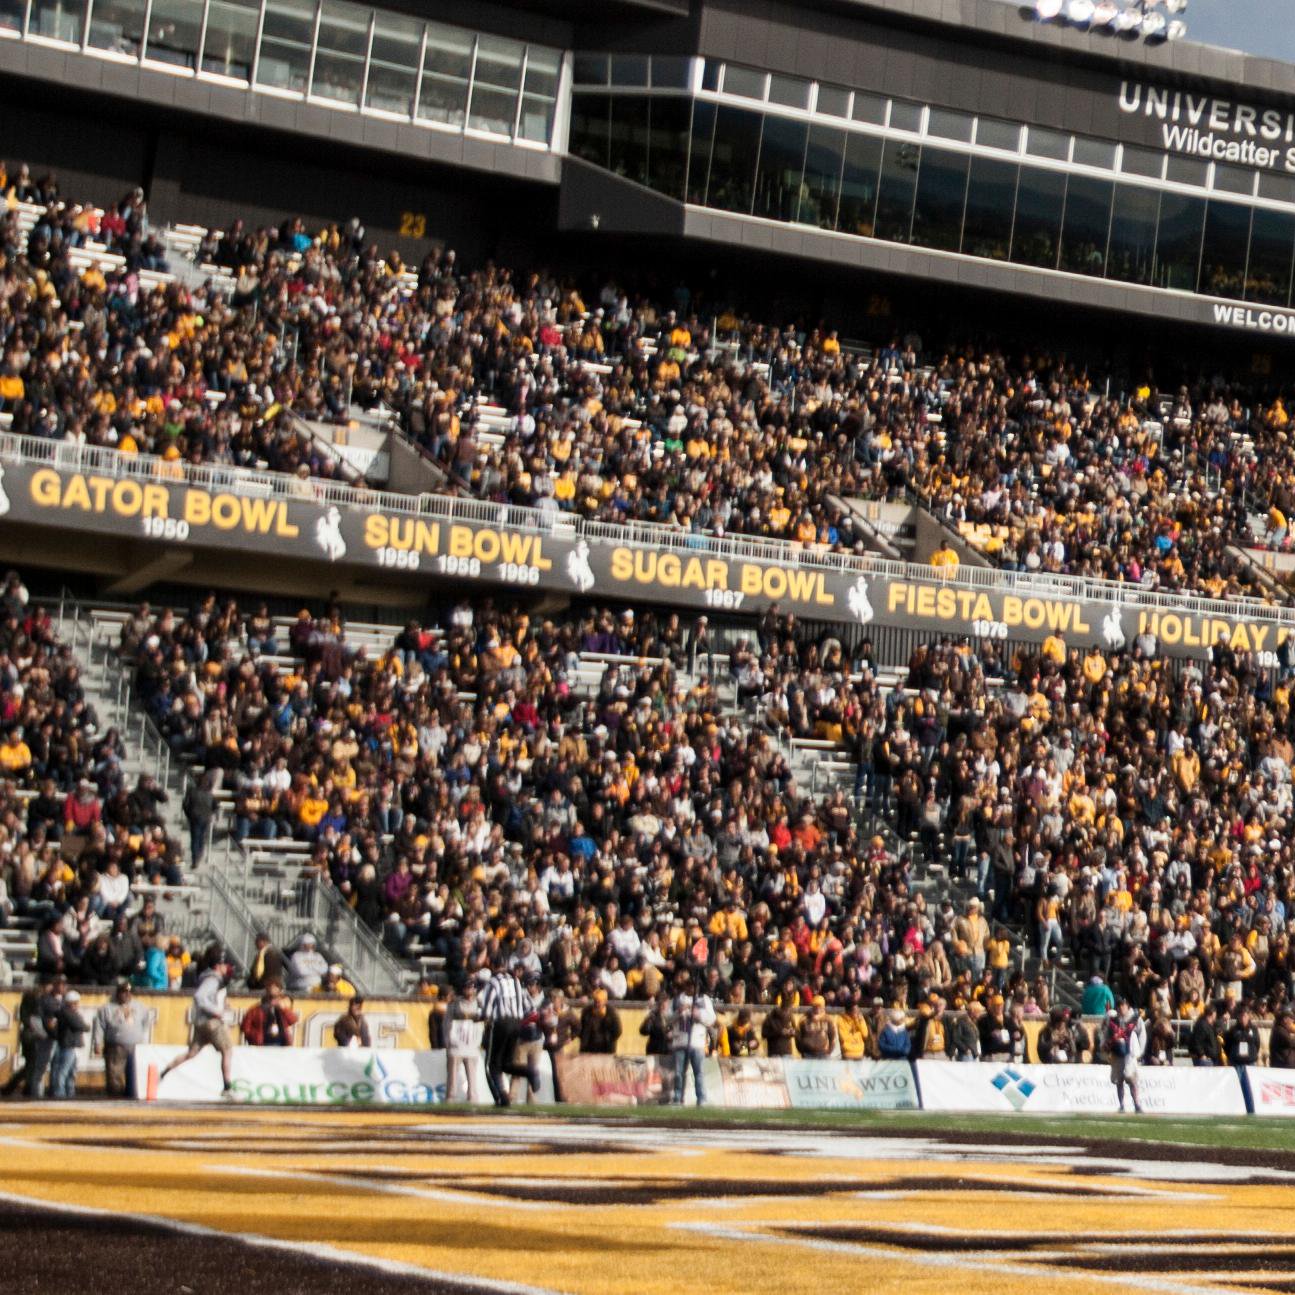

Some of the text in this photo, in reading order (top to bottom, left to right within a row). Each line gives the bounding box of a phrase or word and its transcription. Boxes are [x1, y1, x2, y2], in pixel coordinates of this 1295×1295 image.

[1162, 123, 1280, 168] Wildcatter
[401, 212, 426, 239] 23
[29, 468, 300, 538] GATOR BOWL
[143, 515, 190, 541] 1950
[365, 514, 553, 571] SUN BOWL
[376, 546, 540, 586] 1956 1958 1966
[611, 547, 835, 605] SUGAR BOWL
[704, 588, 745, 610] 1967
[888, 582, 1090, 634] FIESTA BOWL
[972, 619, 1009, 640] 1976
[230, 1078, 376, 1103] Source
[860, 1075, 909, 1092] WYO
